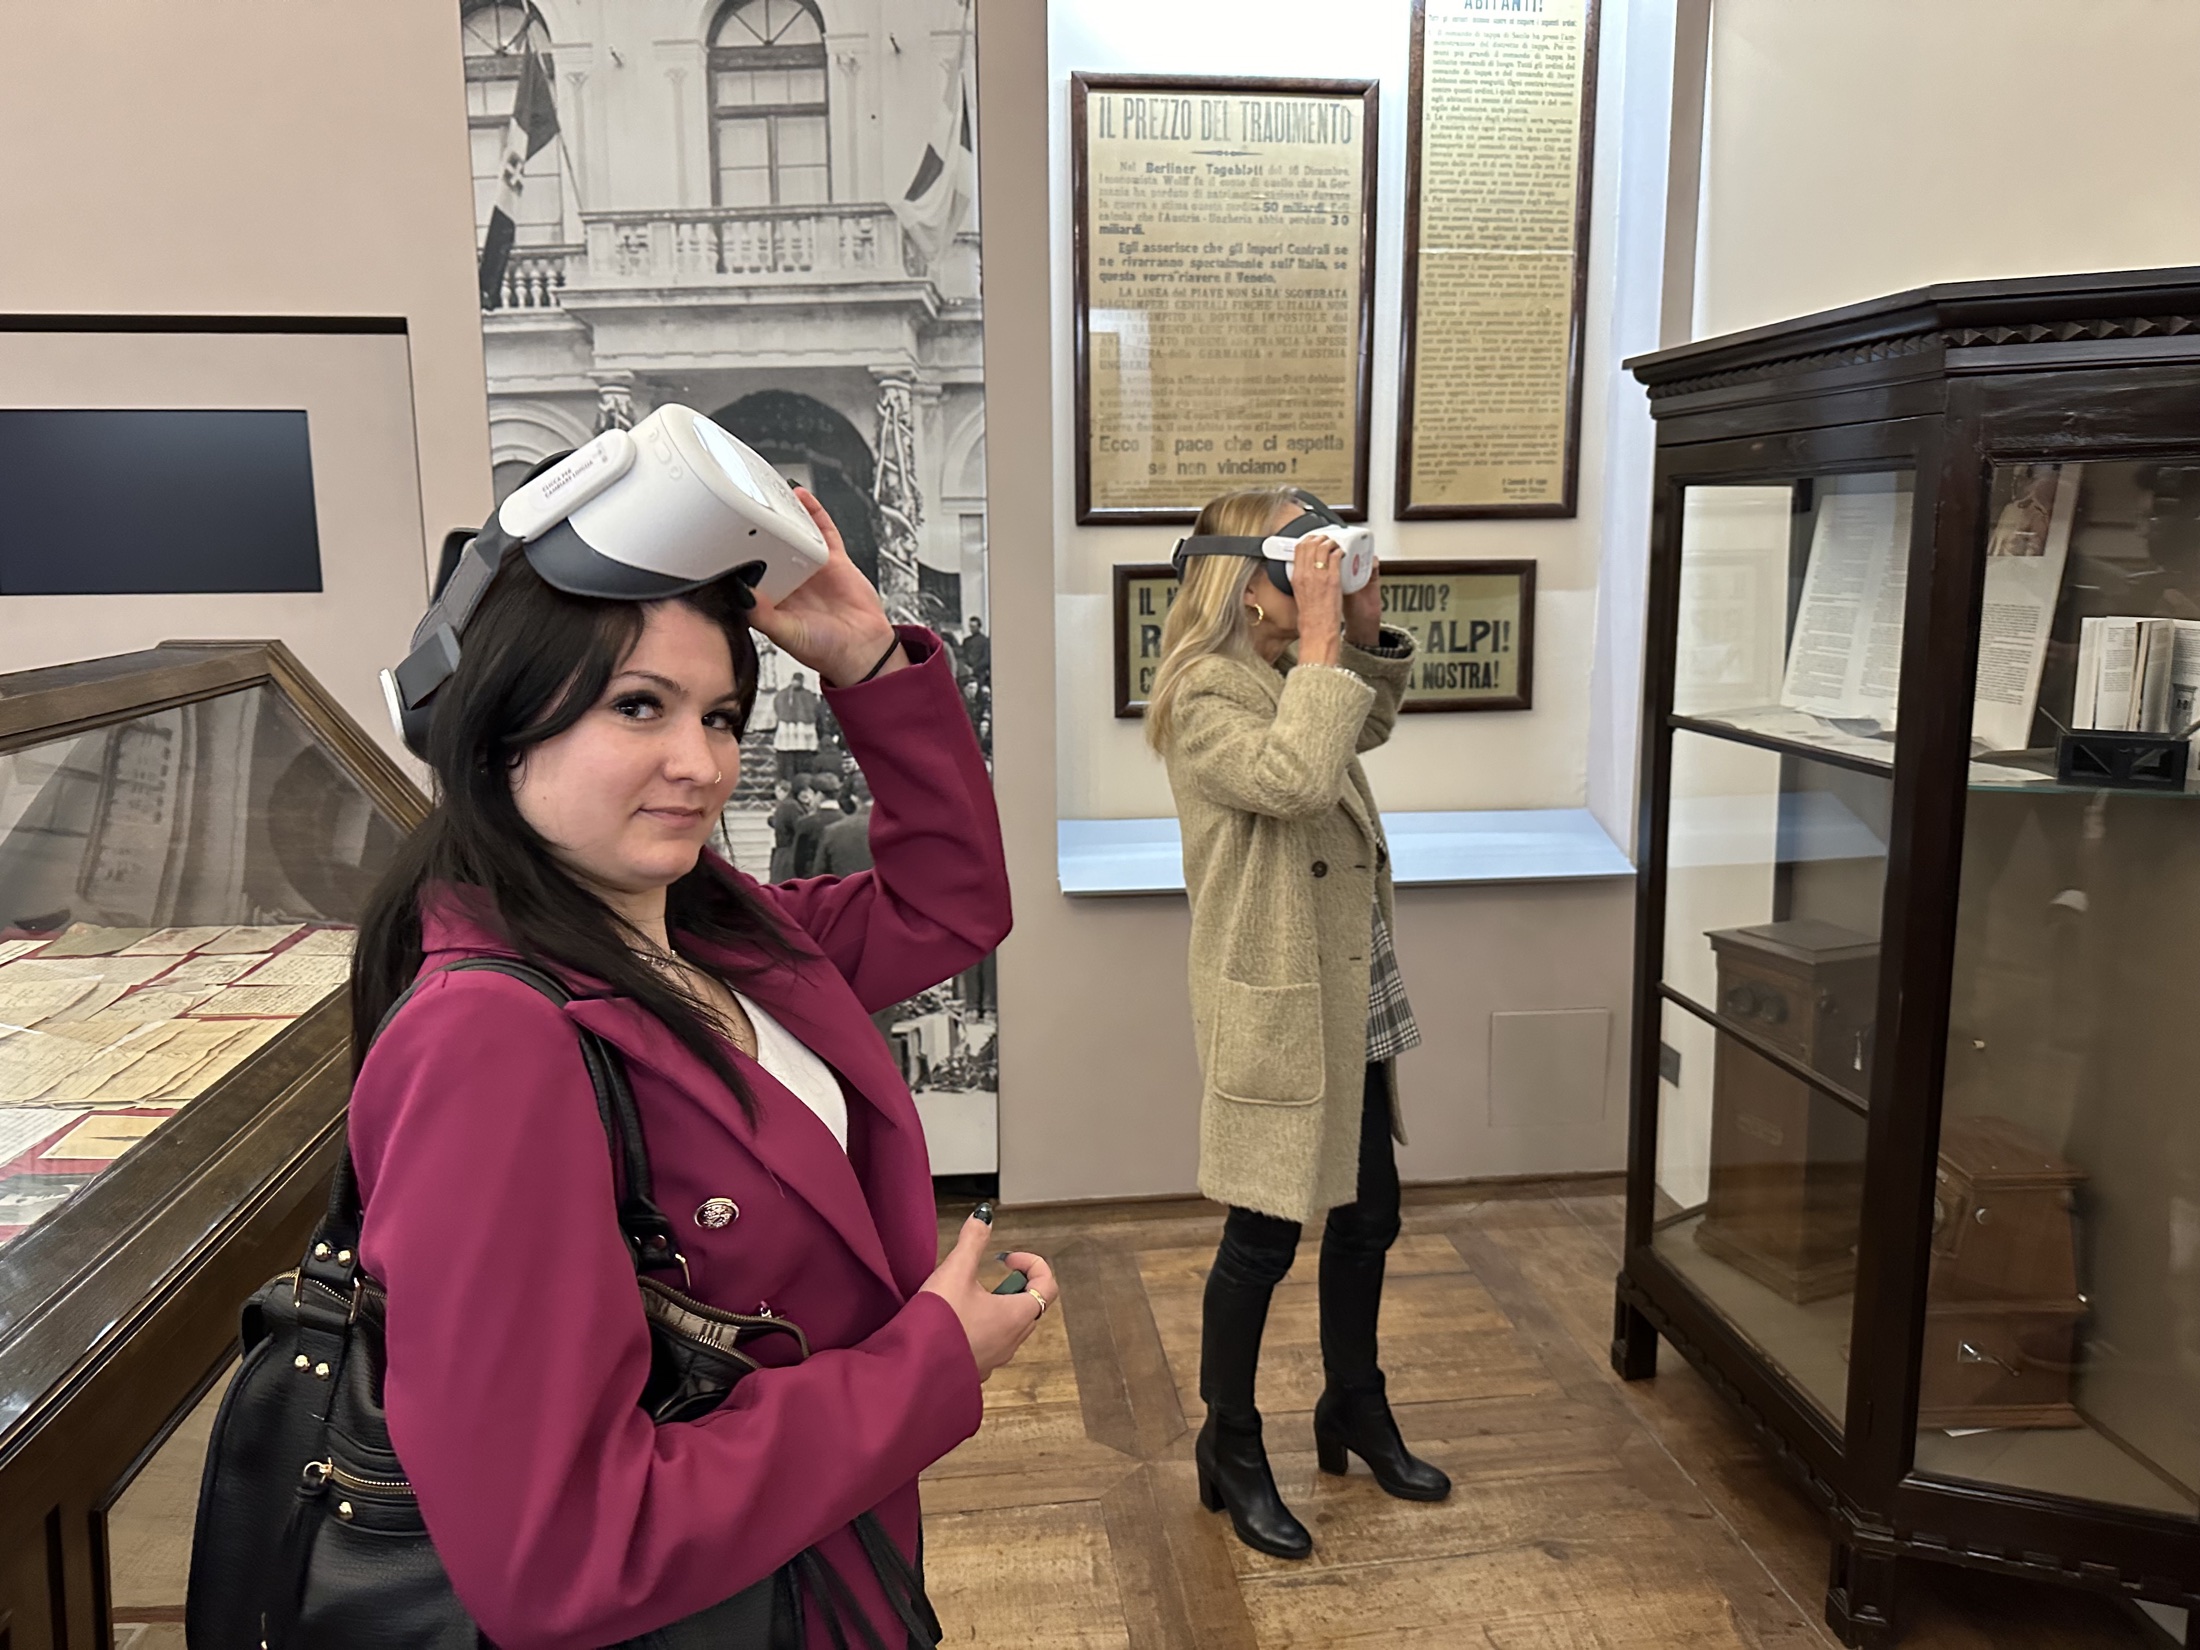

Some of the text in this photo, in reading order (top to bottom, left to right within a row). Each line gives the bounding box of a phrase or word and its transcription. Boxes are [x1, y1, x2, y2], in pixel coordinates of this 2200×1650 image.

[1099, 97, 1352, 144] IL PREZZO DEL TRADIMENTO
[1146, 162, 1196, 174] Berliner
[1206, 163, 1263, 177] Tageblatt
[1263, 202, 1279, 213] 50
[1119, 241, 1139, 255] Egli
[1142, 242, 1199, 254] asserisce
[1203, 242, 1224, 254] che
[1229, 241, 1243, 256] gli
[1287, 241, 1331, 255] Centrali
[1334, 245, 1349, 255] se
[1333, 258, 1349, 270] se
[1099, 272, 1136, 283] questa
[1119, 287, 1132, 297] LA
[1137, 288, 1168, 297] LINEA
[1191, 288, 1224, 298] PIAVE
[1227, 288, 1248, 298] NON
[1285, 289, 1348, 298] SGOMBRATA
[1099, 435, 1140, 452] Ecco
[1175, 438, 1213, 456] pace
[1224, 435, 1253, 452] che
[1262, 435, 1278, 451] ci
[1286, 433, 1345, 455] aspetta
[1148, 461, 1167, 475] se
[1177, 462, 1207, 475] non
[1217, 457, 1287, 475] vinciamo
[1139, 587, 1156, 615] IL
[1380, 584, 1450, 612] STIZIO?
[1425, 620, 1510, 653] ALPI!
[1422, 661, 1499, 689] NOSTRA!
